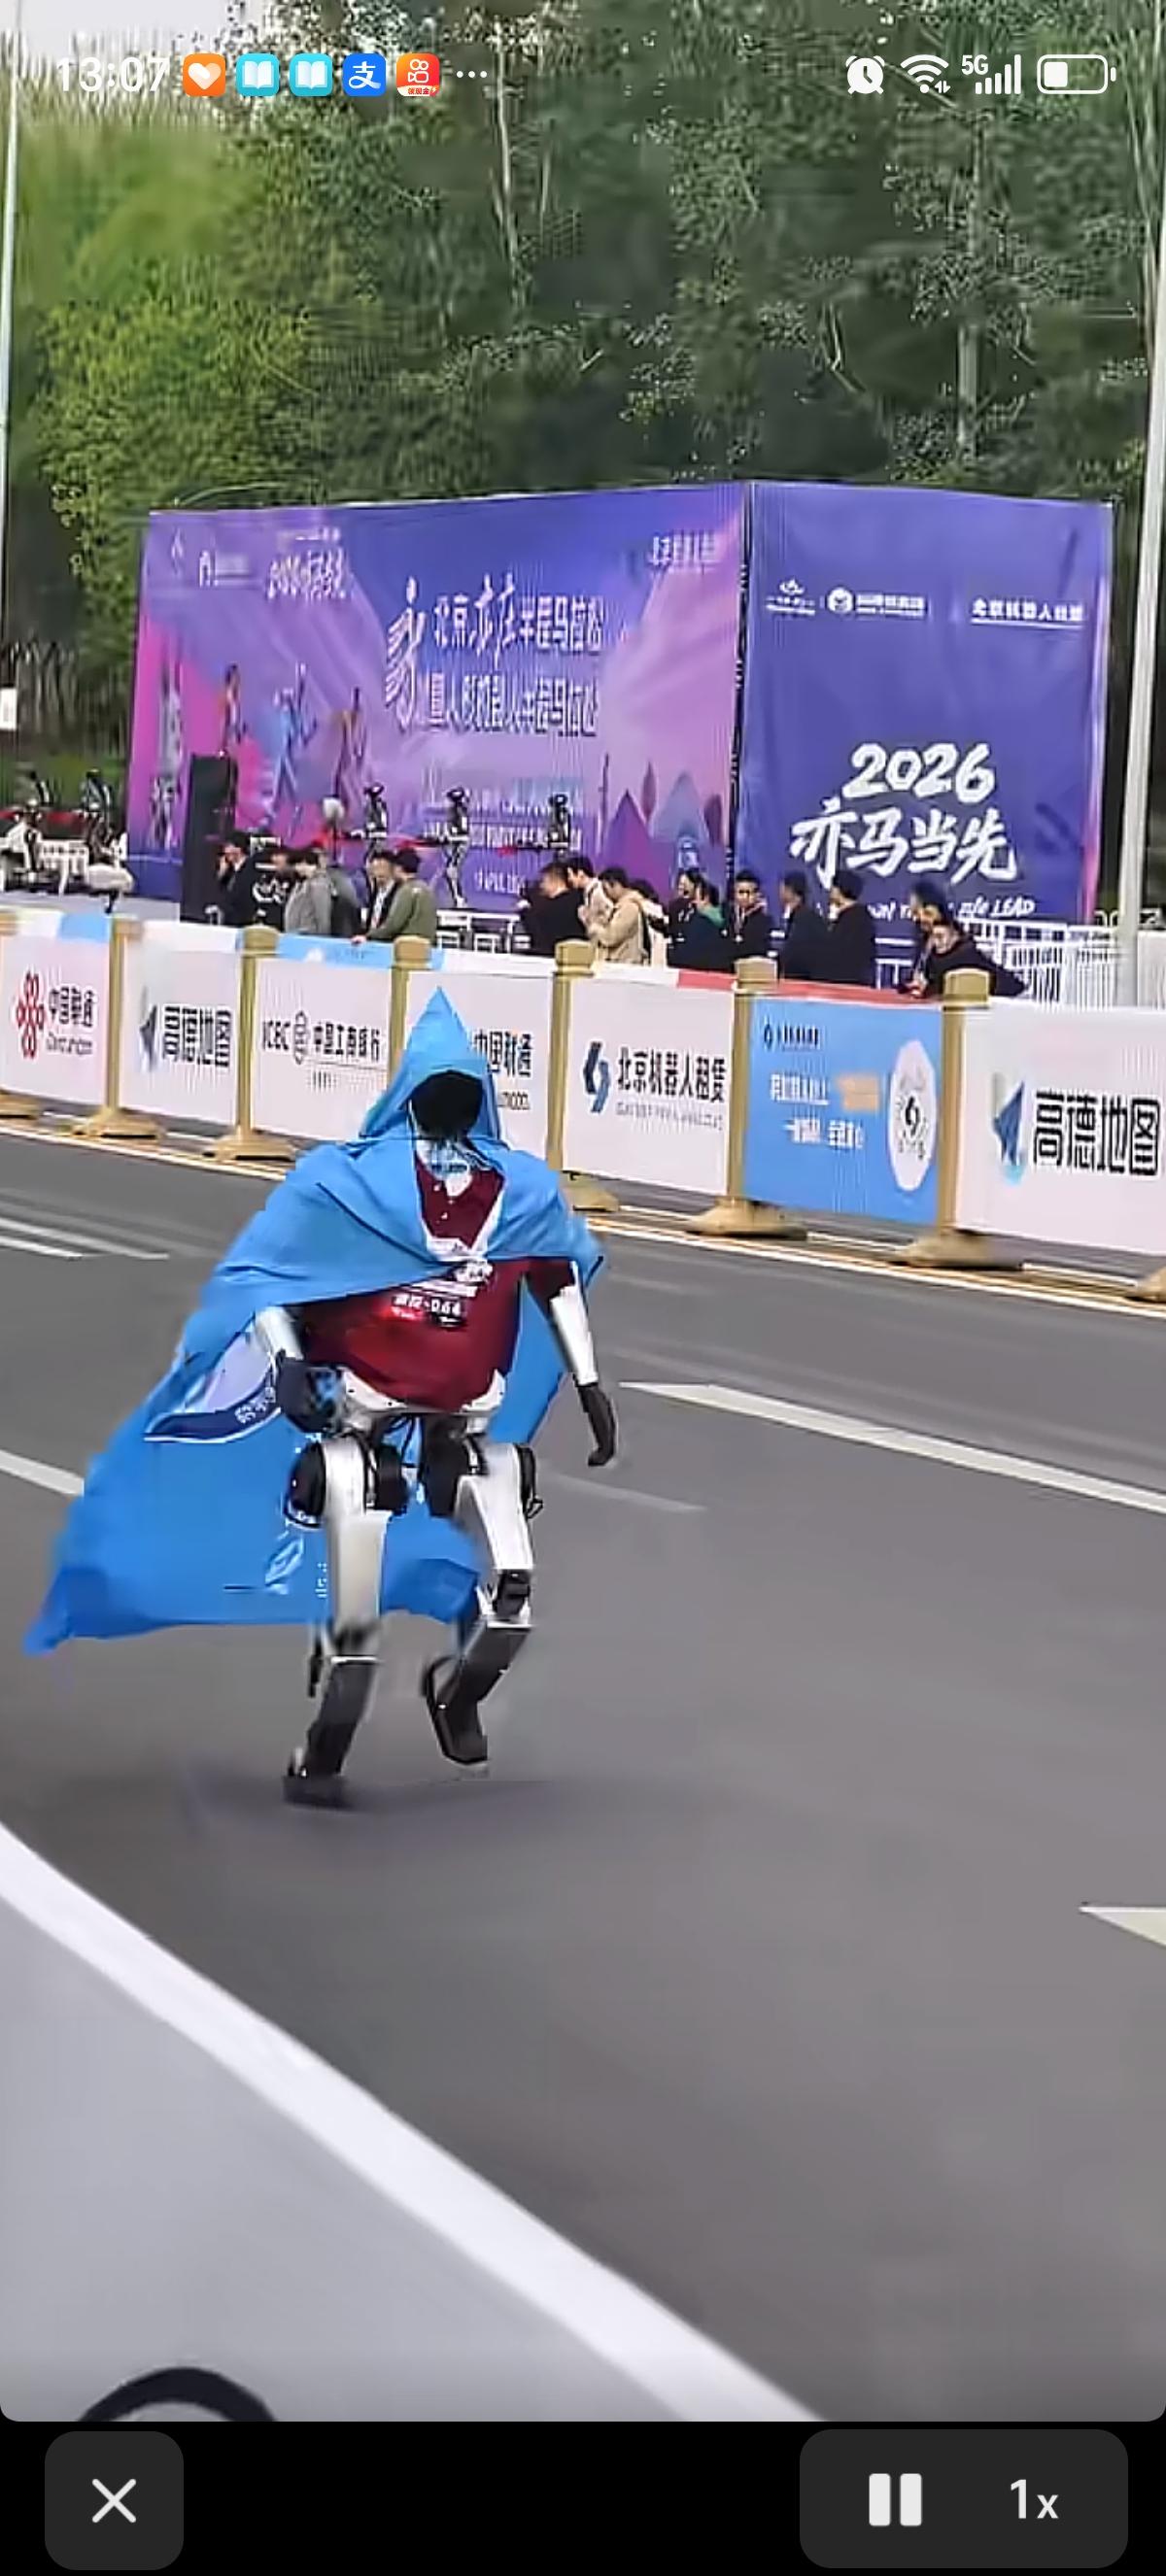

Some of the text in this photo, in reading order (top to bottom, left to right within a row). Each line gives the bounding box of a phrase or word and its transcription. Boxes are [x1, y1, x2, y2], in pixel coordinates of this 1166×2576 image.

[841, 742, 996, 804] 2026
[789, 797, 1017, 890] 亦马当先
[162, 1005, 232, 1068] 高德地图
[617, 1046, 725, 1102] 北京机器人租赁
[1033, 1089, 1160, 1176] 高德地图
